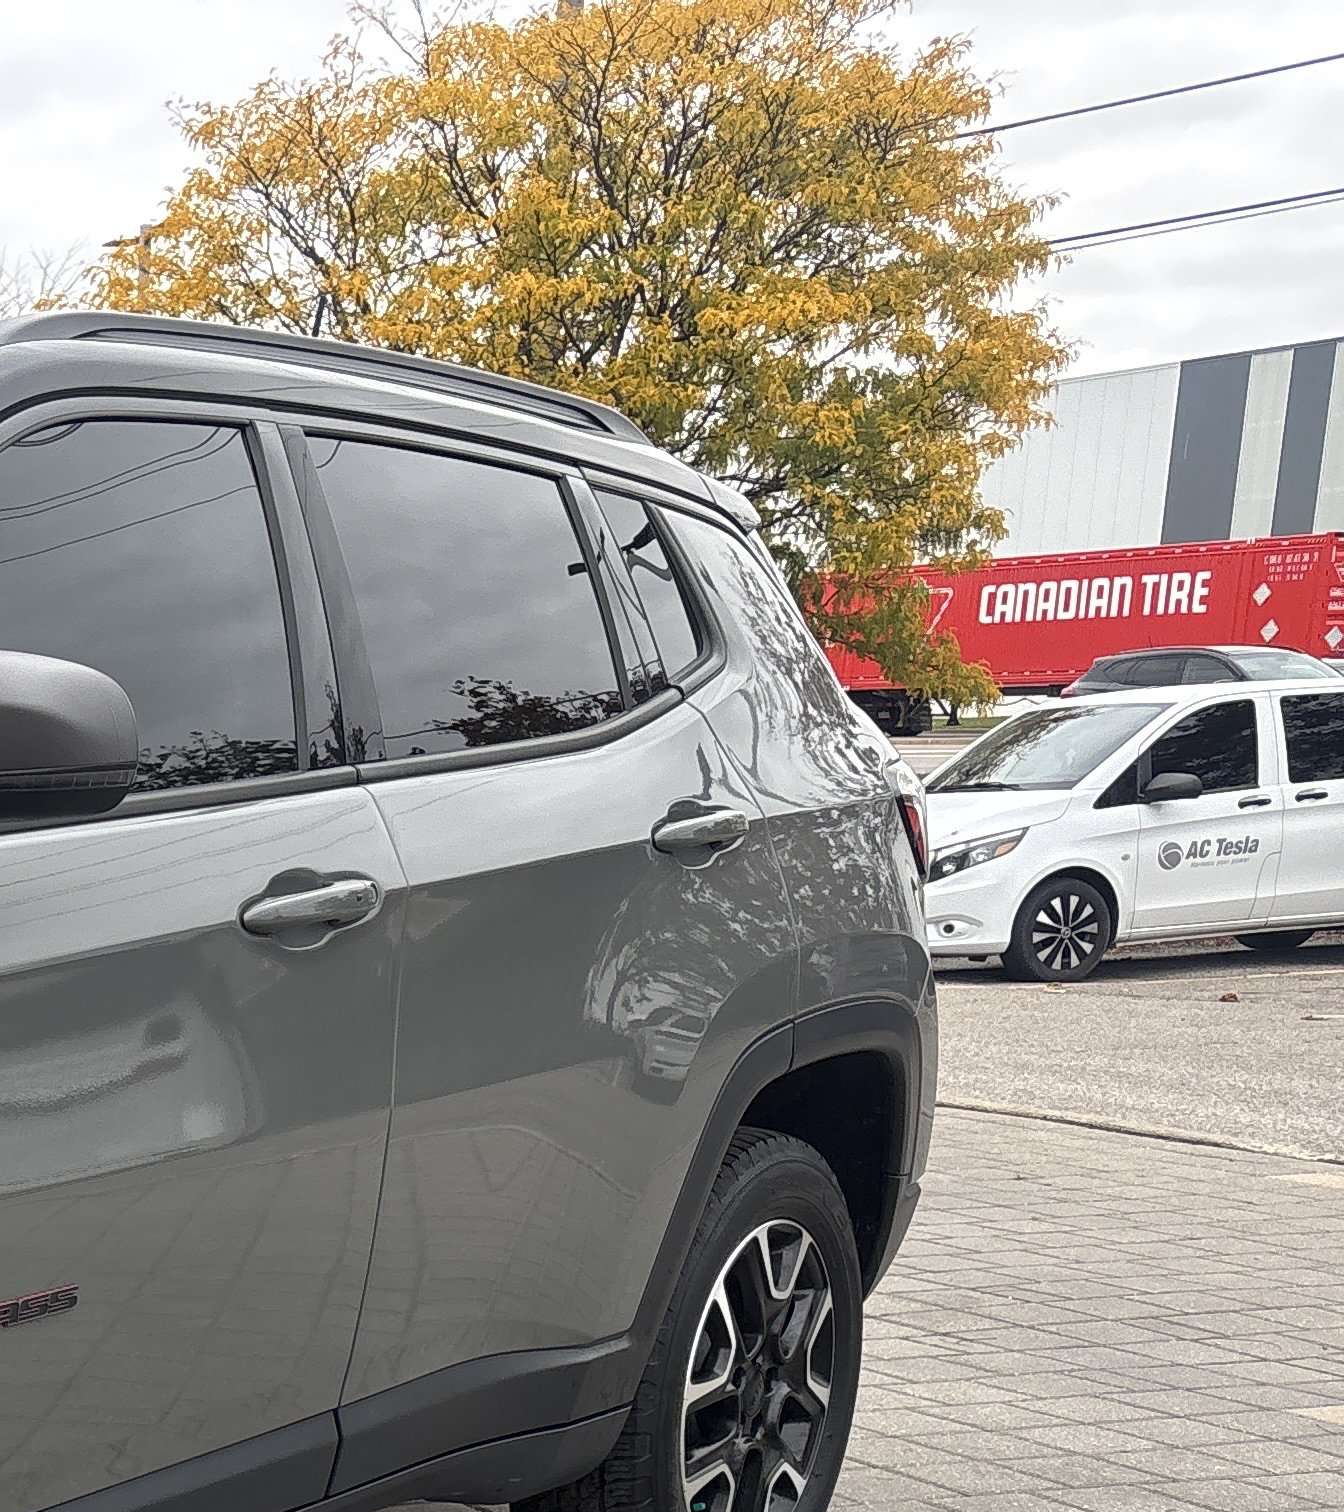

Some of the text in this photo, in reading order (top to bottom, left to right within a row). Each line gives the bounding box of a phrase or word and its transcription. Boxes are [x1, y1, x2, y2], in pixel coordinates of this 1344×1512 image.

[978, 570, 1213, 625] CANADIAN TIRE
[1185, 836, 1260, 860] AC Tesla
